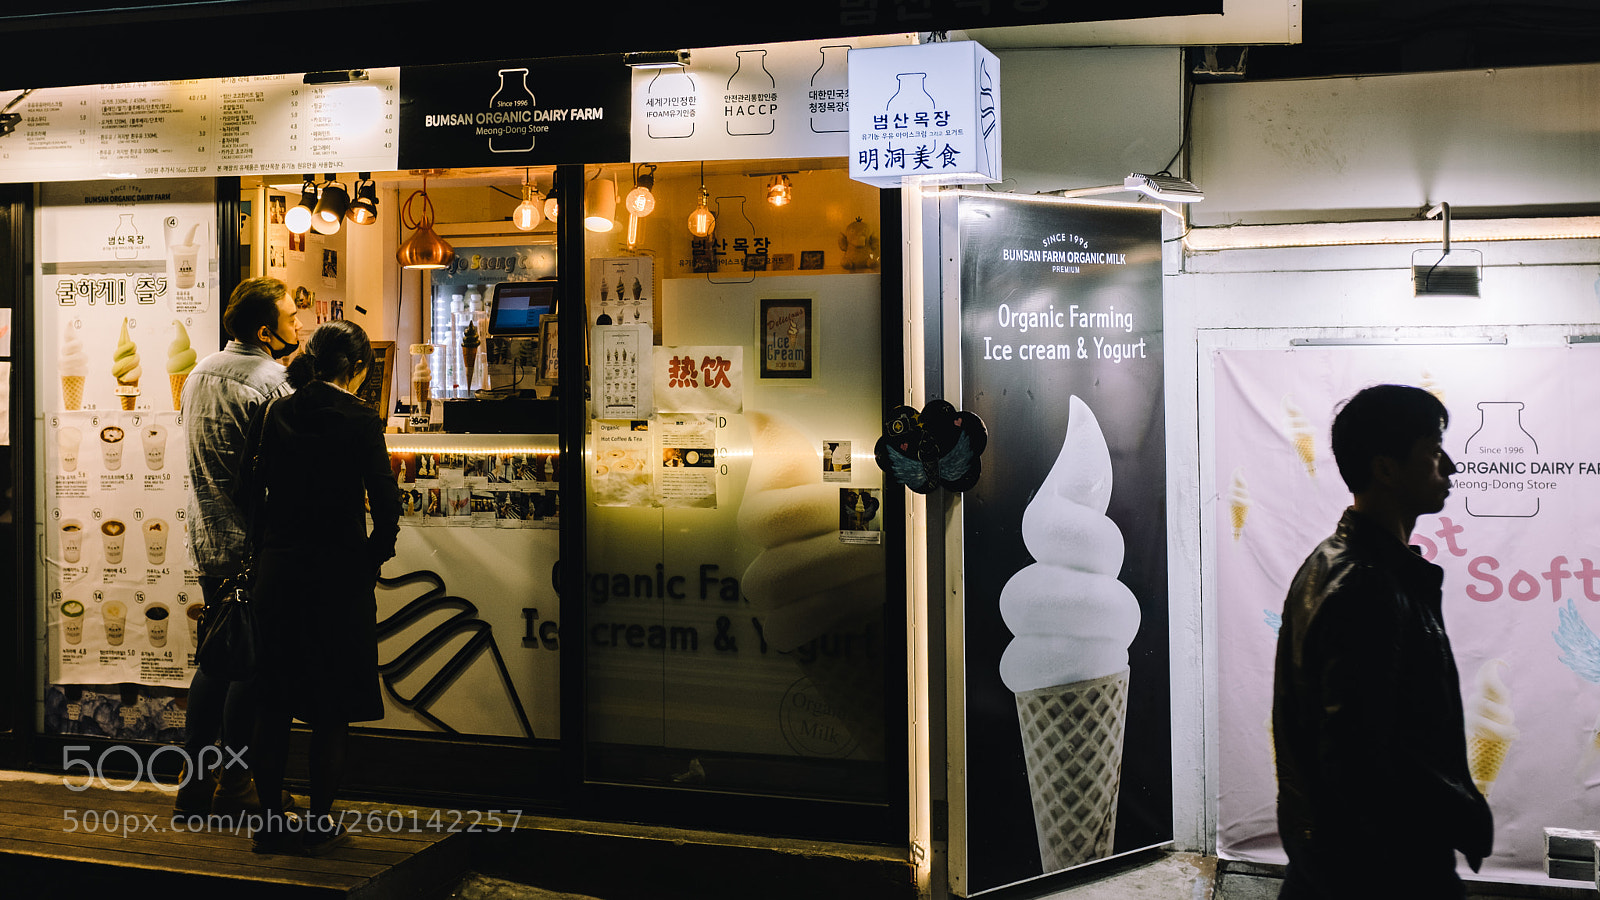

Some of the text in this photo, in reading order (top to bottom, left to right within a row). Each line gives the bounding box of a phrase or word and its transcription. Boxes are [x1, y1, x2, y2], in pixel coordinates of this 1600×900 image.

[513, 99, 528, 107] 1996
[645, 96, 697, 108] 세계가인정한
[724, 92, 778, 103] 안전관리통합인증
[425, 107, 604, 127] BUMSAN ORGANIC DAIRY FARM
[724, 104, 778, 117] HACCP
[873, 110, 951, 130] 범산목장
[475, 124, 549, 136] Meong-Dong Store
[862, 132, 879, 141] 유기농
[895, 131, 927, 139] 아이스크림
[945, 128, 964, 136] 요거트
[858, 142, 961, 172] 明洞美食
[84, 193, 171, 204] BUMSAN ORGANIC DAIRY FARM
[108, 235, 145, 245] 범산목장
[691, 237, 771, 256] 범산목장
[1042, 233, 1089, 249] SINCE 1996
[1003, 249, 1126, 265] BUMSAN FARM ORGANIC MILK
[1052, 265, 1080, 273] PREMIUM
[56, 279, 126, 305] 쿨하게!
[767, 308, 803, 330] Delicious
[998, 304, 1133, 332] Organic Farming
[773, 332, 790, 349] Ice
[767, 344, 805, 361] Cream
[983, 336, 1147, 363] Ice cream & Yogurt
[668, 355, 732, 389] 热饮
[600, 424, 620, 432] Organic
[1479, 446, 1524, 454] Since 1996
[1455, 461, 1527, 475] ORGANIC
[1530, 462, 1574, 475] DAIRY
[125, 473, 134, 481] 5.8
[1450, 480, 1557, 491] Meong-Dong Store
[80, 566, 88, 574] 3.2
[1466, 555, 1600, 602] Soft
[590, 621, 698, 651] cream
[714, 616, 739, 653] &
[752, 616, 879, 663] Ygurt
[78, 648, 87, 656] 4.8
[127, 649, 136, 657] 5.0
[800, 720, 840, 745] Milk
